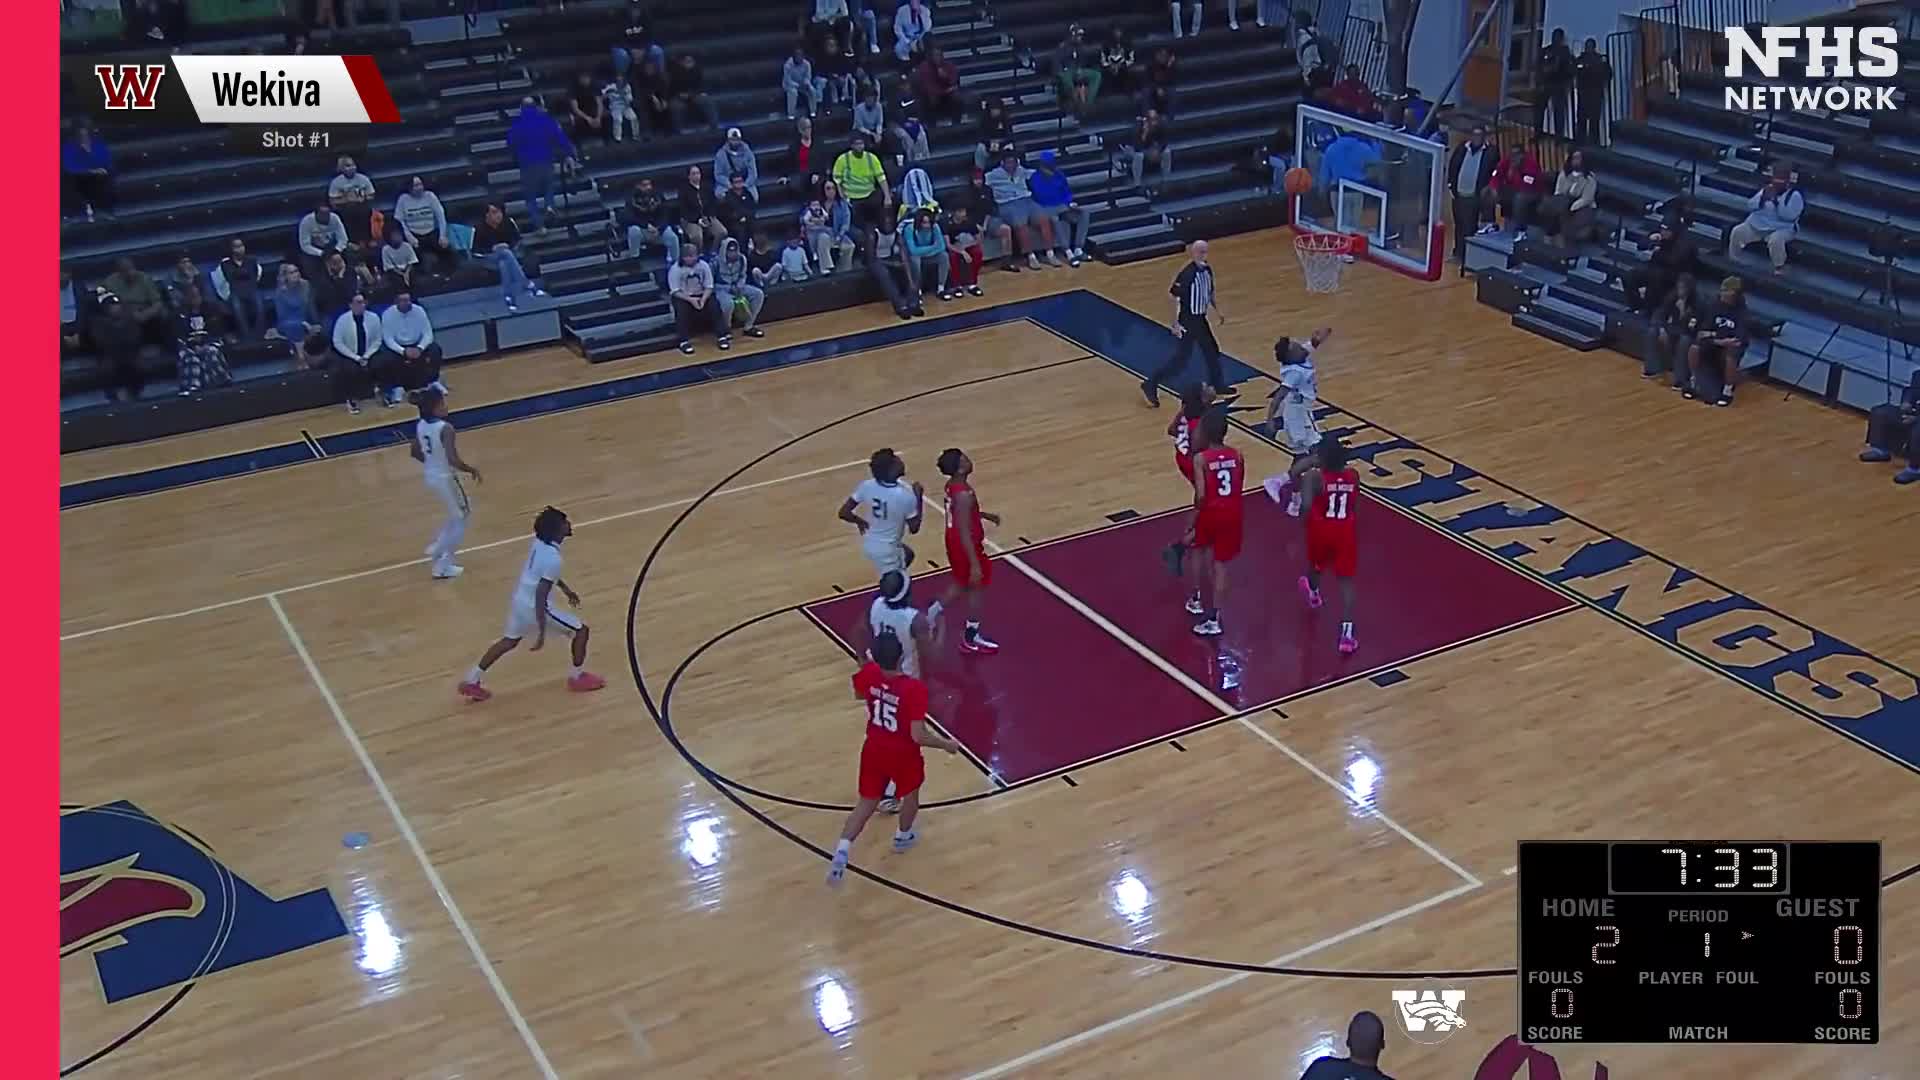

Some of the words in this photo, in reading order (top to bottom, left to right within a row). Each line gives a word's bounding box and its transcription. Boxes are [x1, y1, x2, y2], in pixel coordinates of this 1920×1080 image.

[1216, 469, 1232, 496] 3
[871, 497, 889, 521] 21
[1325, 492, 1348, 520] 11
[872, 699, 898, 733] 15
